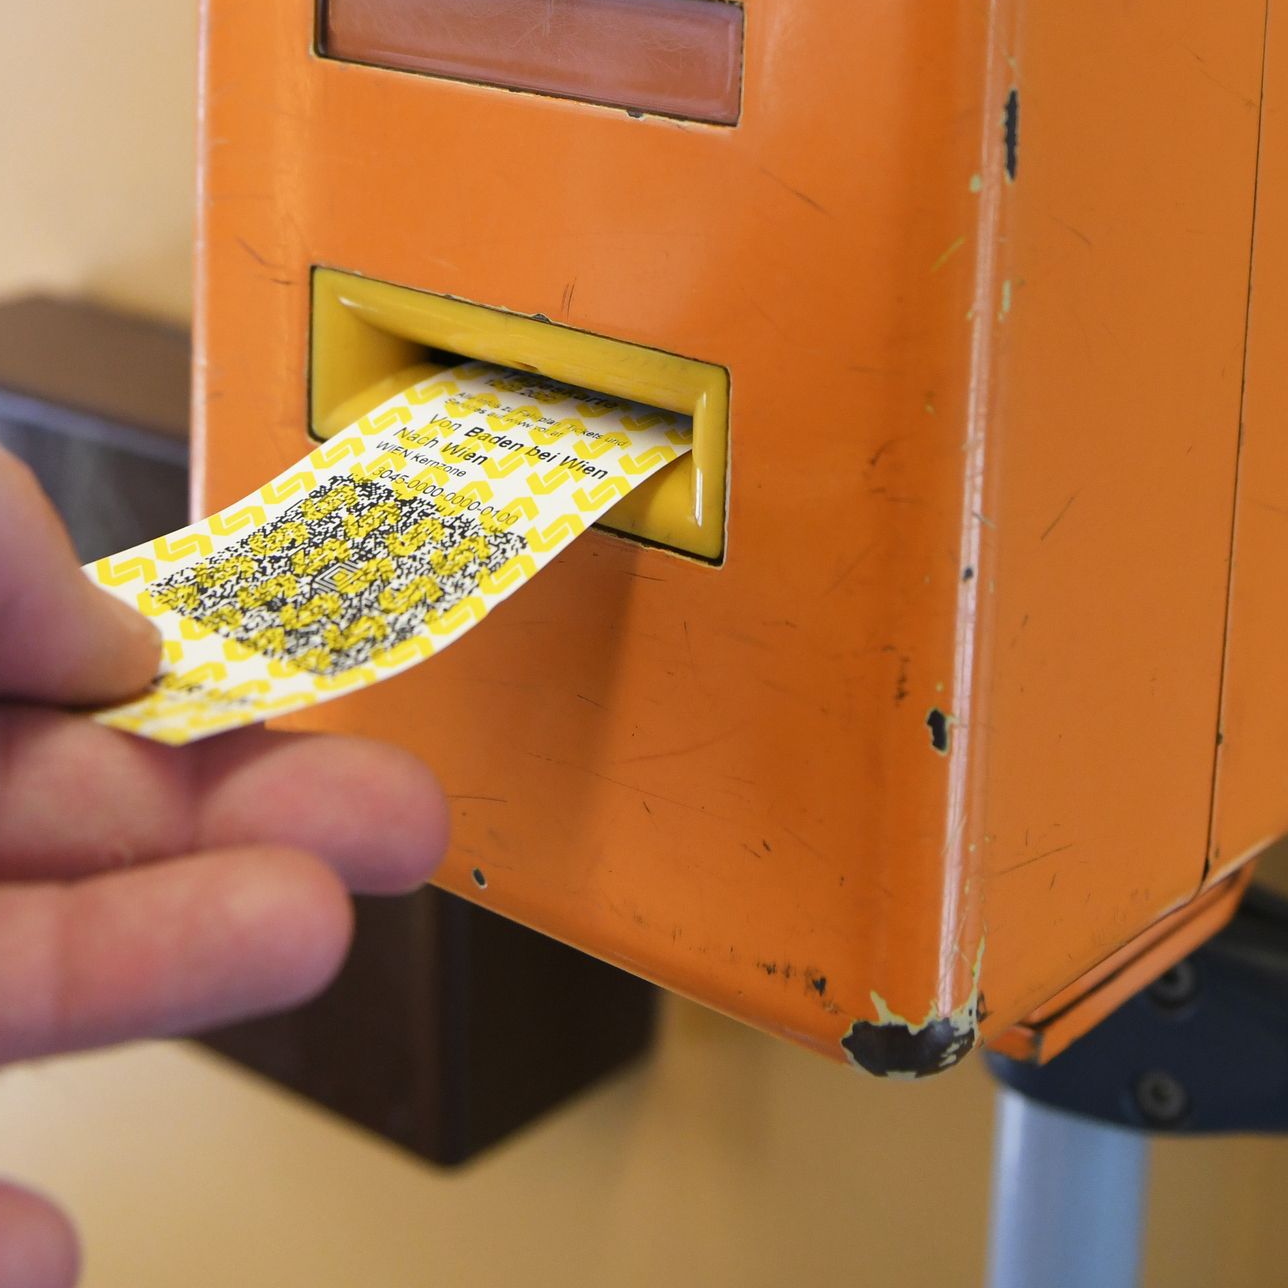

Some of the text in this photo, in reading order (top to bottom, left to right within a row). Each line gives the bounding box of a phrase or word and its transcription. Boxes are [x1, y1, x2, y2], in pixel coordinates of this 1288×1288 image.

[376, 440, 467, 478] WIEN Kernzone
[393, 426, 489, 466] Nach Wien
[430, 413, 609, 480] Von Baden bei Wien
[372, 466, 520, 525] 3045-0000-0000-0100
